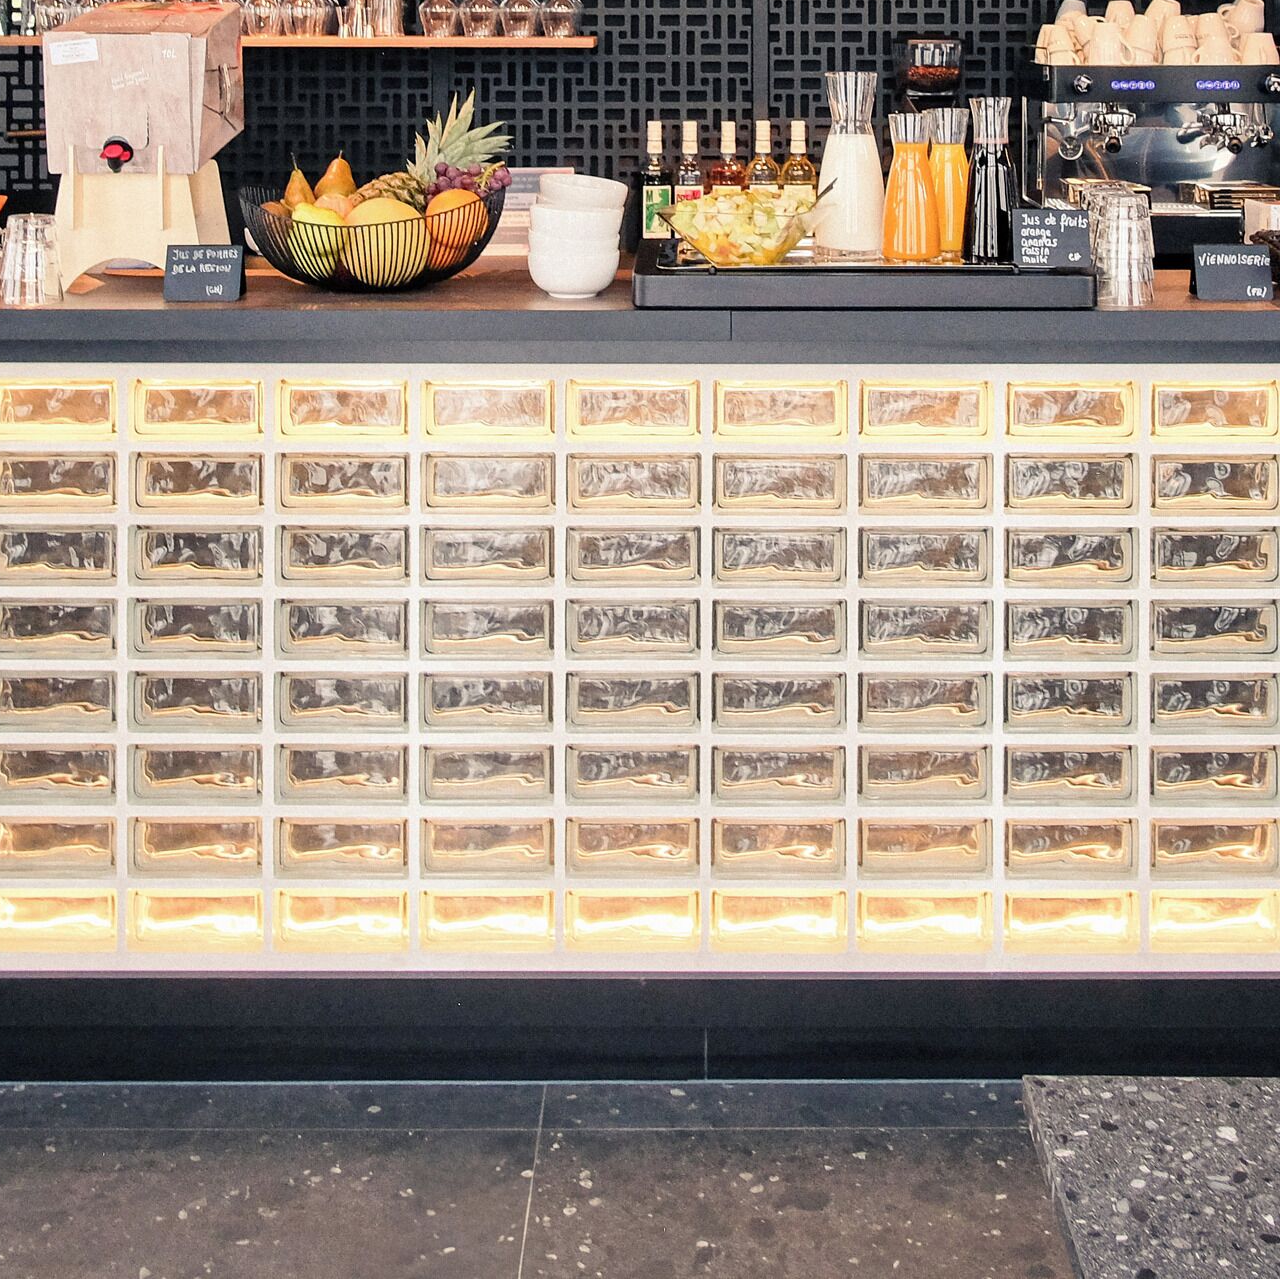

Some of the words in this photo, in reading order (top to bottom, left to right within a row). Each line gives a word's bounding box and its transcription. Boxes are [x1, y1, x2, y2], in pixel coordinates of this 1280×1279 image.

[1021, 213, 1040, 225] Jus
[1044, 213, 1057, 226] de
[1060, 213, 1089, 232] fruits
[1021, 228, 1052, 239] orange
[1021, 238, 1058, 247] ananas
[1022, 246, 1050, 256] raisin
